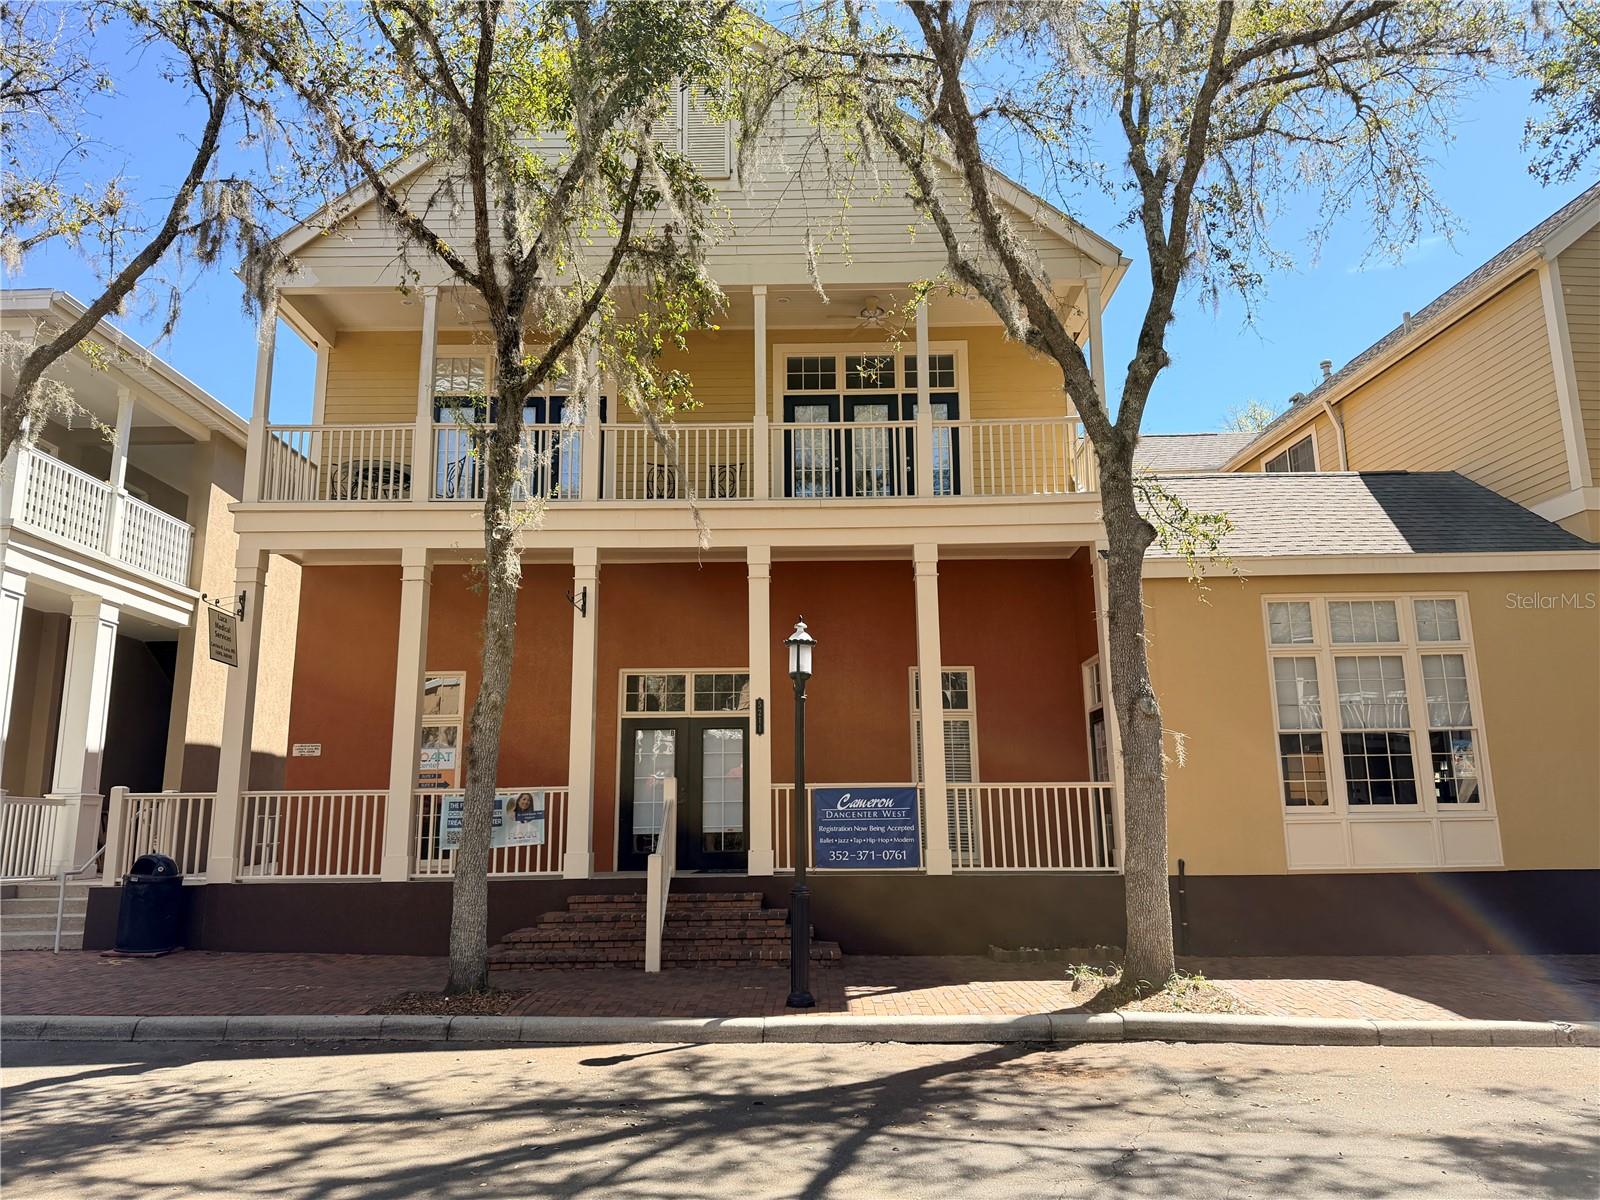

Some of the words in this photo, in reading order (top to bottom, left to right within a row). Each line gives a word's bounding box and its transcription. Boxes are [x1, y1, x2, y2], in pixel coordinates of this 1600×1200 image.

[214, 621, 231, 633] Medical
[214, 630, 231, 642] Services
[420, 752, 453, 762] OAAT
[837, 793, 894, 810] Cameron
[819, 825, 852, 833] Registration
[869, 825, 885, 833] Being
[829, 850, 906, 861] 352-371-0761
